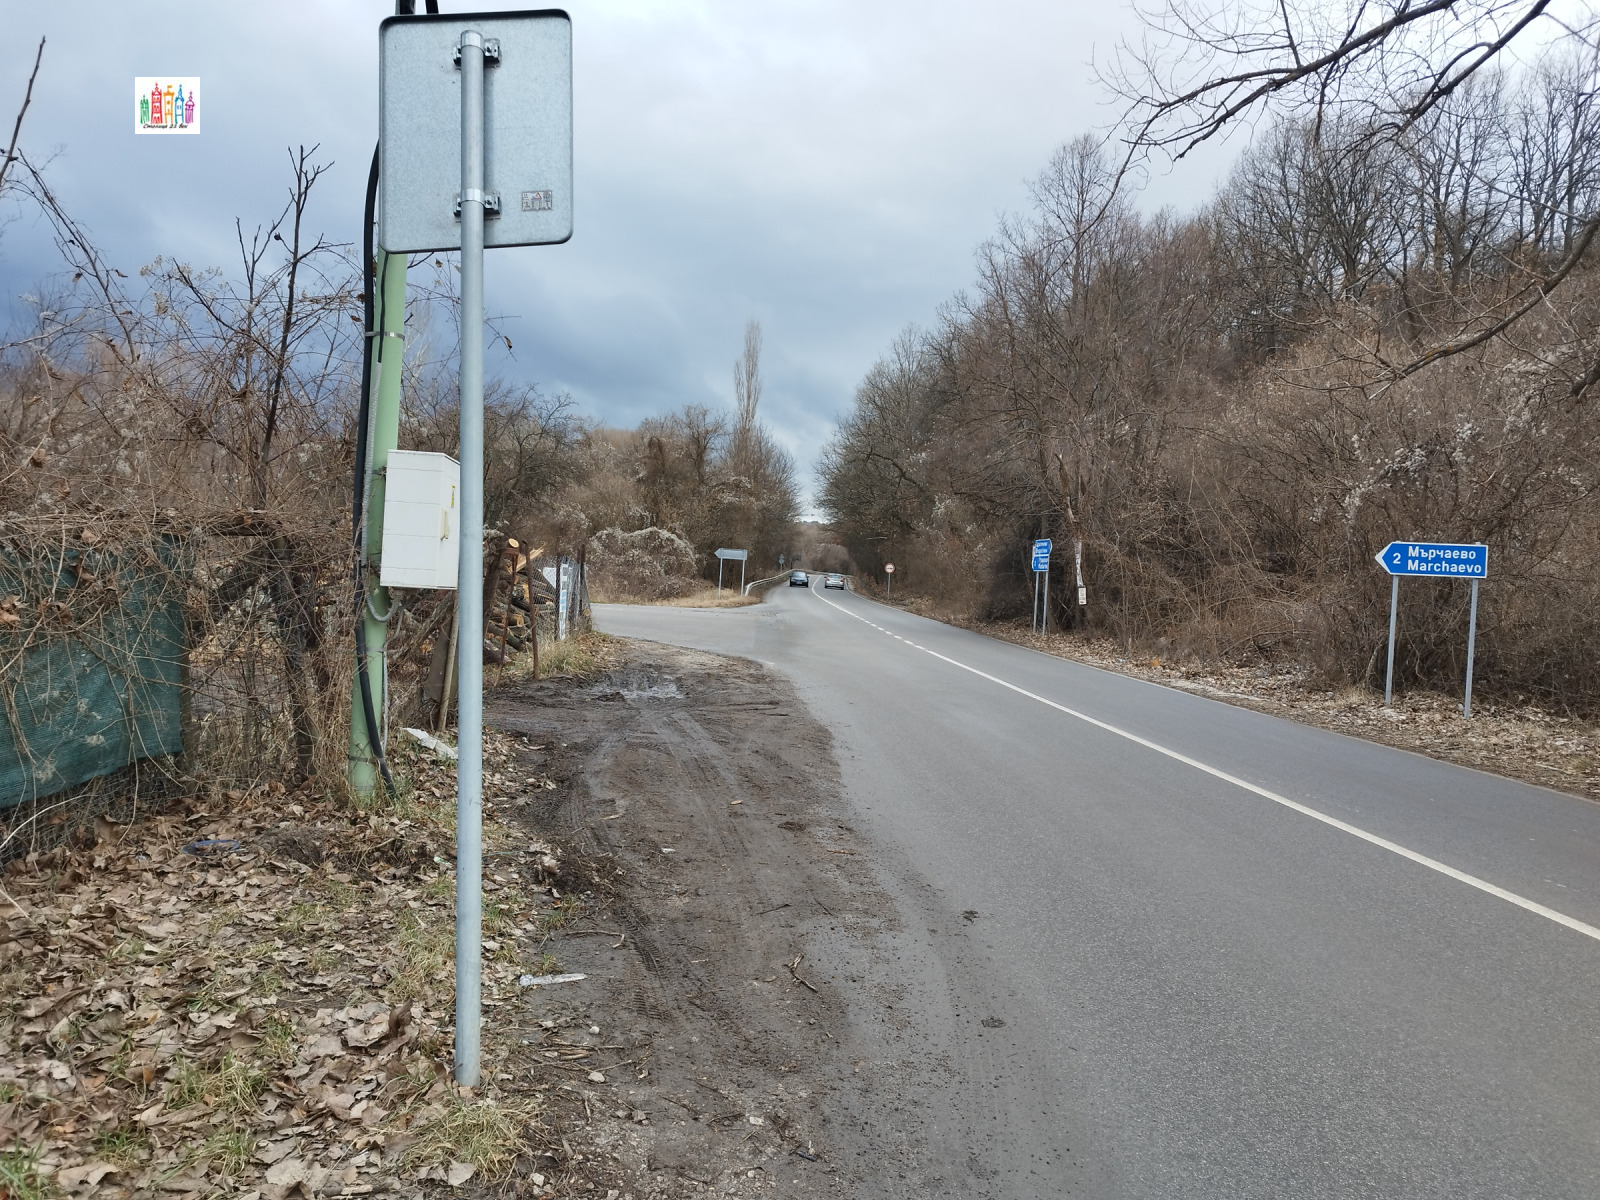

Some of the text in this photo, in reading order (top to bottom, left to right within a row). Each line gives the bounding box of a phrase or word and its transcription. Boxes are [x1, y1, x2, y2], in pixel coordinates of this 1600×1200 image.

[1392, 552, 1401, 564] 2
[1408, 545, 1476, 560] Мърчаево
[1407, 559, 1482, 573] Marchaevo
